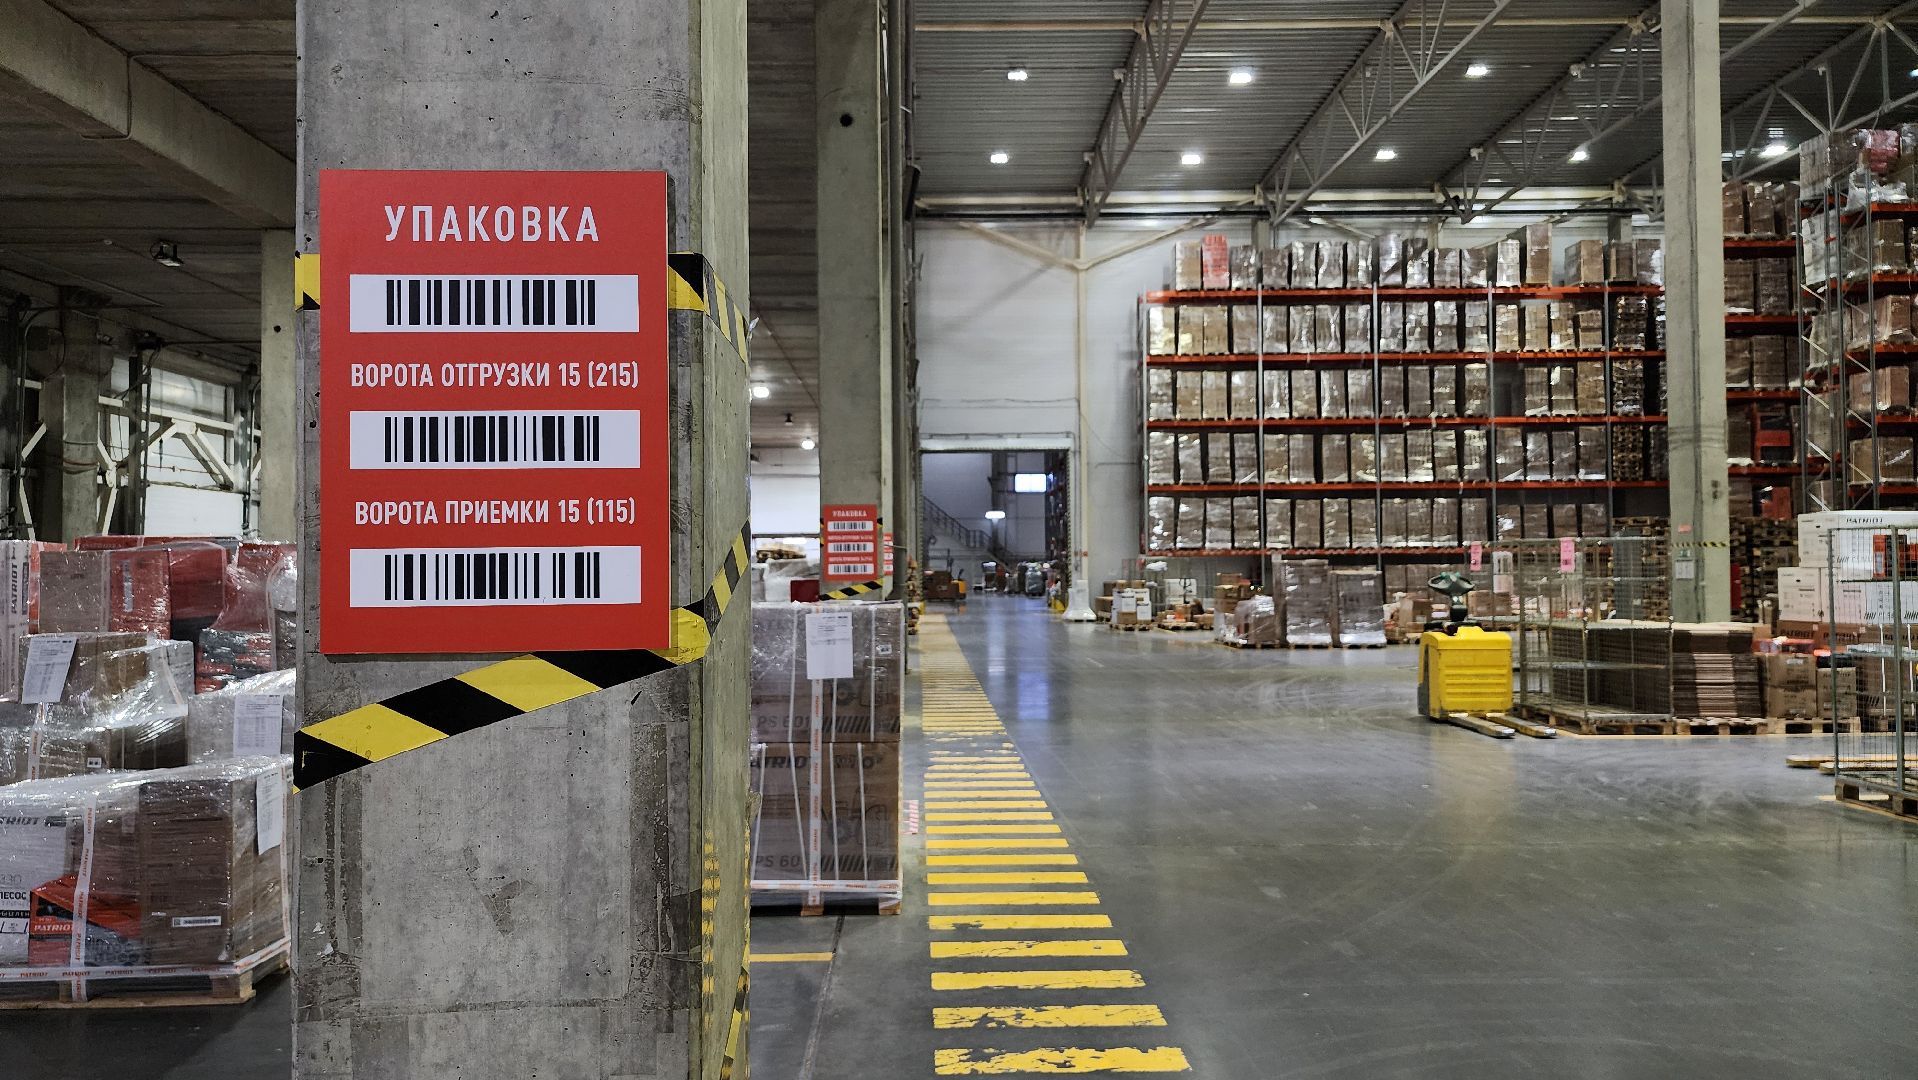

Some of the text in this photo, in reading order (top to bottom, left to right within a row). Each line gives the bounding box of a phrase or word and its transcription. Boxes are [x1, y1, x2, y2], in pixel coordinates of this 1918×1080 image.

[384, 205, 600, 242] УПАКОВКА
[351, 360, 639, 389] ВОРОТА ОТГРУЗКИ 15 (215)
[355, 496, 635, 526] ВОРОТА ПРИЕМКИ 15 (115)
[750, 755, 811, 769] ATRIO
[0, 816, 40, 825] TRIOT
